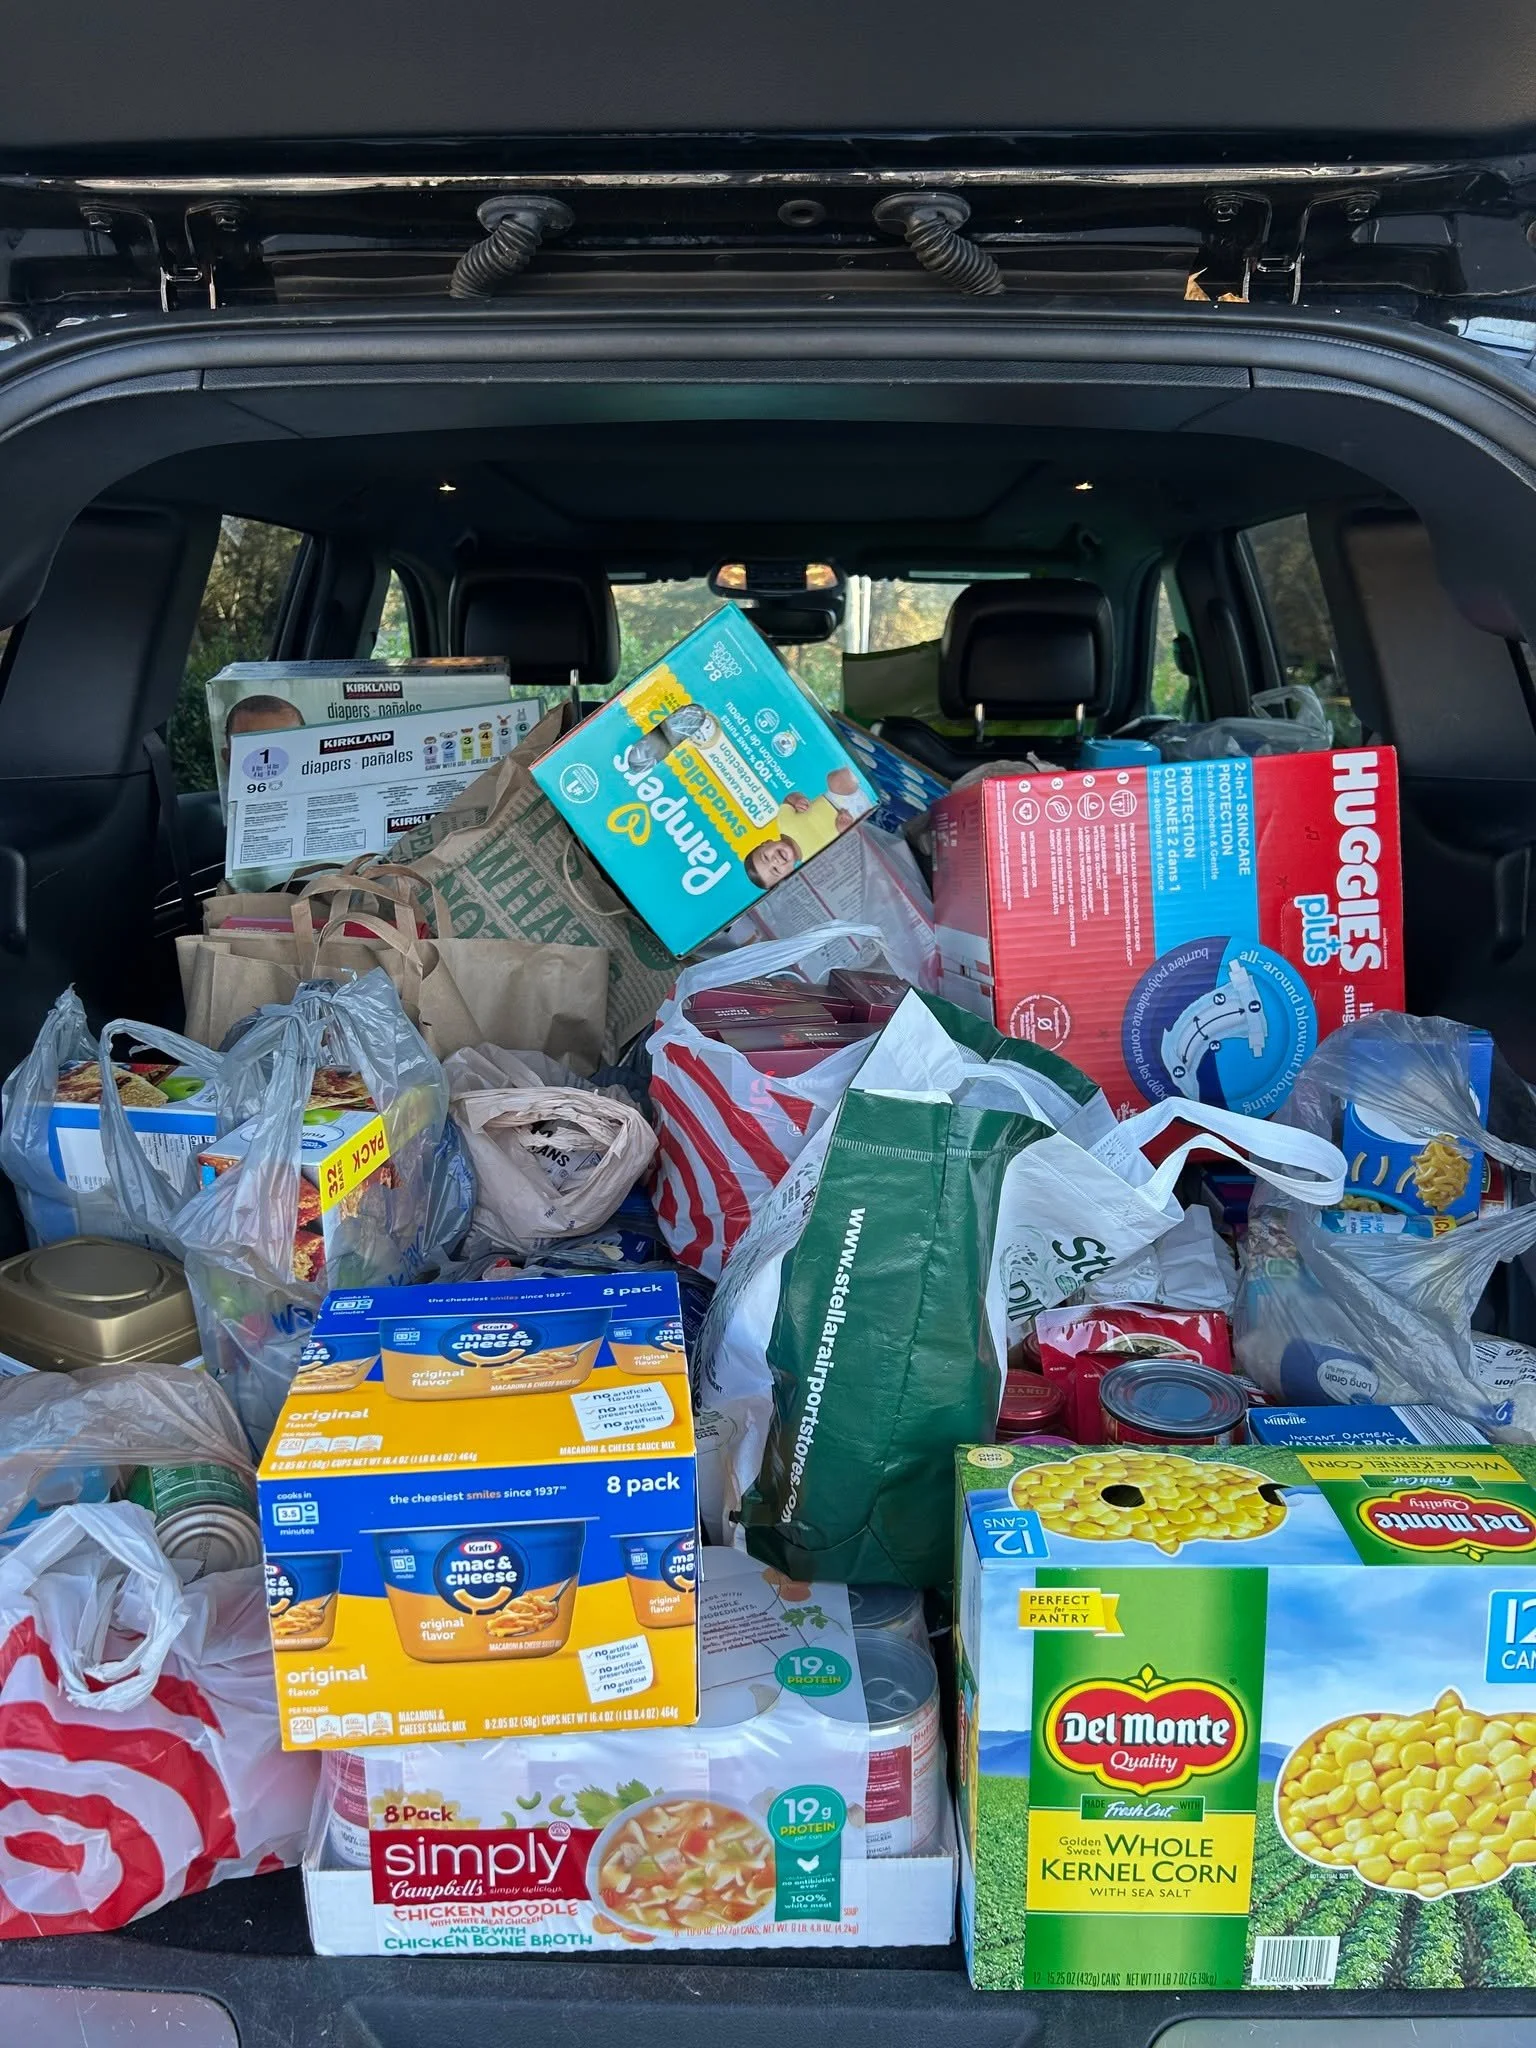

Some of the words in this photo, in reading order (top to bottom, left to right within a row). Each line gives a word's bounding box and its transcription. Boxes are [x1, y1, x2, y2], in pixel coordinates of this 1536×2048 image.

[709, 651, 733, 678] DIAPERS
[714, 641, 742, 675] COUCHES
[704, 661, 722, 681] 84
[346, 682, 400, 693] KIRKLAND
[327, 702, 370, 720] diapers
[725, 702, 747, 724] peau
[720, 715, 737, 735] FUITES
[742, 725, 752, 736] la
[323, 732, 392, 749] KIRKLAND
[736, 734, 753, 756] SANS
[750, 734, 761, 747] de
[259, 749, 269, 764] 1
[301, 756, 351, 776] diapers
[361, 748, 413, 770] pañales
[708, 753, 743, 792] LEAKPROOF
[719, 743, 757, 792] protection
[754, 759, 773, 782] 100
[759, 745, 795, 789] protection
[1206, 764, 1214, 788] Extra
[1234, 762, 1248, 800] 2-in-1
[246, 782, 267, 794] 96
[758, 792, 775, 815] skin
[1164, 767, 1180, 834] CUTANÉE
[1152, 770, 1163, 849] Extra-absorbante
[1181, 766, 1196, 858] PROTECTION
[1208, 791, 1217, 839] Absorbent
[1219, 764, 1234, 856] PROTECTION
[613, 744, 732, 895] Pampers
[1167, 838, 1179, 846] 2
[1236, 803, 1251, 876] SKINCARE
[1156, 852, 1163, 860] et
[1210, 849, 1219, 880] Gentle
[1332, 751, 1382, 973] HUGGIES
[1168, 850, 1179, 882] dans
[1157, 863, 1165, 890] douce
[1167, 947, 1209, 976] barrière
[1239, 950, 1303, 1004] all-around
[1132, 967, 1171, 1027] polyvalente
[1291, 1006, 1307, 1067] blowout
[1132, 1028, 1144, 1064] contre
[1137, 1064, 1151, 1080] les
[1242, 1070, 1297, 1115] blocking
[352, 1130, 385, 1173] PACK
[327, 1165, 339, 1198] 32
[337, 1159, 345, 1190] BARS
[602, 1287, 614, 1296] 8
[619, 1284, 662, 1296] pack
[459, 1332, 506, 1341] mac
[511, 1330, 529, 1340] &
[1324, 1373, 1348, 1386] Grain
[1349, 1379, 1373, 1392] Long
[288, 1408, 369, 1422] original
[1263, 1415, 1307, 1426] Millville
[1342, 1431, 1396, 1440] OATMEAL
[1308, 1460, 1363, 1469] CORN
[1369, 1460, 1433, 1469] KERNEL
[1434, 1461, 1508, 1471] WHOLE
[606, 1476, 621, 1494] 8
[627, 1472, 680, 1498] pack
[277, 1492, 302, 1501] cooks
[389, 1495, 409, 1505] the
[411, 1491, 464, 1503] cheesiest
[466, 1489, 502, 1500] smiles
[503, 1488, 533, 1499] since
[1409, 1497, 1470, 1511] Quality
[281, 1509, 297, 1519] 3.5
[1374, 1512, 1477, 1532] Monte
[280, 1527, 315, 1535] minutes
[983, 1518, 1028, 1528] CANS
[1477, 1514, 1531, 1534] Del
[468, 1543, 493, 1552] Kraft
[988, 1530, 1035, 1555] 12
[450, 1557, 495, 1572] mac
[497, 1555, 513, 1570] &
[1030, 1595, 1091, 1605] PERFECT
[1030, 1613, 1090, 1623] PANTRY
[1053, 1606, 1065, 1614] for
[419, 1616, 465, 1632] original
[421, 1629, 456, 1642] flavor
[595, 1649, 608, 1658] no
[609, 1642, 639, 1655] artificial
[605, 1651, 631, 1661] flavors
[287, 1664, 368, 1686] original
[599, 1666, 613, 1674] no
[613, 1659, 643, 1671] artificial
[599, 1664, 646, 1681] preservatives
[603, 1682, 617, 1691] no
[617, 1675, 647, 1688] artificial
[787, 1676, 842, 1684] PROTEIN
[288, 1688, 320, 1697] flavor
[616, 1685, 633, 1694] dyes
[398, 1710, 438, 1722] MACARONI
[438, 1709, 445, 1719] &
[400, 1723, 426, 1736] CHEESE
[428, 1722, 451, 1734] SAUCE
[452, 1721, 466, 1731] MIX
[1063, 1712, 1116, 1744] Del
[1121, 1712, 1230, 1746] Monte
[1110, 1750, 1178, 1773] Quality
[384, 1805, 400, 1823] 8
[403, 1805, 453, 1822] Pack
[1083, 1800, 1106, 1809] MADE
[1104, 1801, 1144, 1818] Fresh
[1179, 1801, 1201, 1809] WITH
[780, 1821, 836, 1836] PROTEIN
[1059, 1837, 1101, 1846] Golden
[1066, 1847, 1102, 1856] Sweet
[1104, 1833, 1214, 1858] WHOLE
[385, 1831, 568, 1887] simply
[1042, 1858, 1145, 1882] KERNEL
[1151, 1861, 1238, 1884] CORN
[389, 1879, 483, 1900] Campbell's
[1089, 1888, 1126, 1896] WITH
[1132, 1889, 1154, 1897] SEA
[1159, 1889, 1192, 1898] SALT
[791, 1895, 827, 1903] 100%
[394, 1905, 485, 1922] CHICKEN
[491, 1902, 579, 1918] NOODLE
[430, 1919, 451, 1928] WITH
[452, 1918, 479, 1926] WHITE
[481, 1918, 504, 1926] MEAT
[505, 1916, 543, 1926] CHICKEN
[449, 1926, 490, 1935] MADE
[492, 1927, 526, 1935] WITH
[384, 1936, 468, 1950] CHICKEN
[473, 1935, 525, 1947] BONE
[531, 1933, 593, 1948] BROTH
